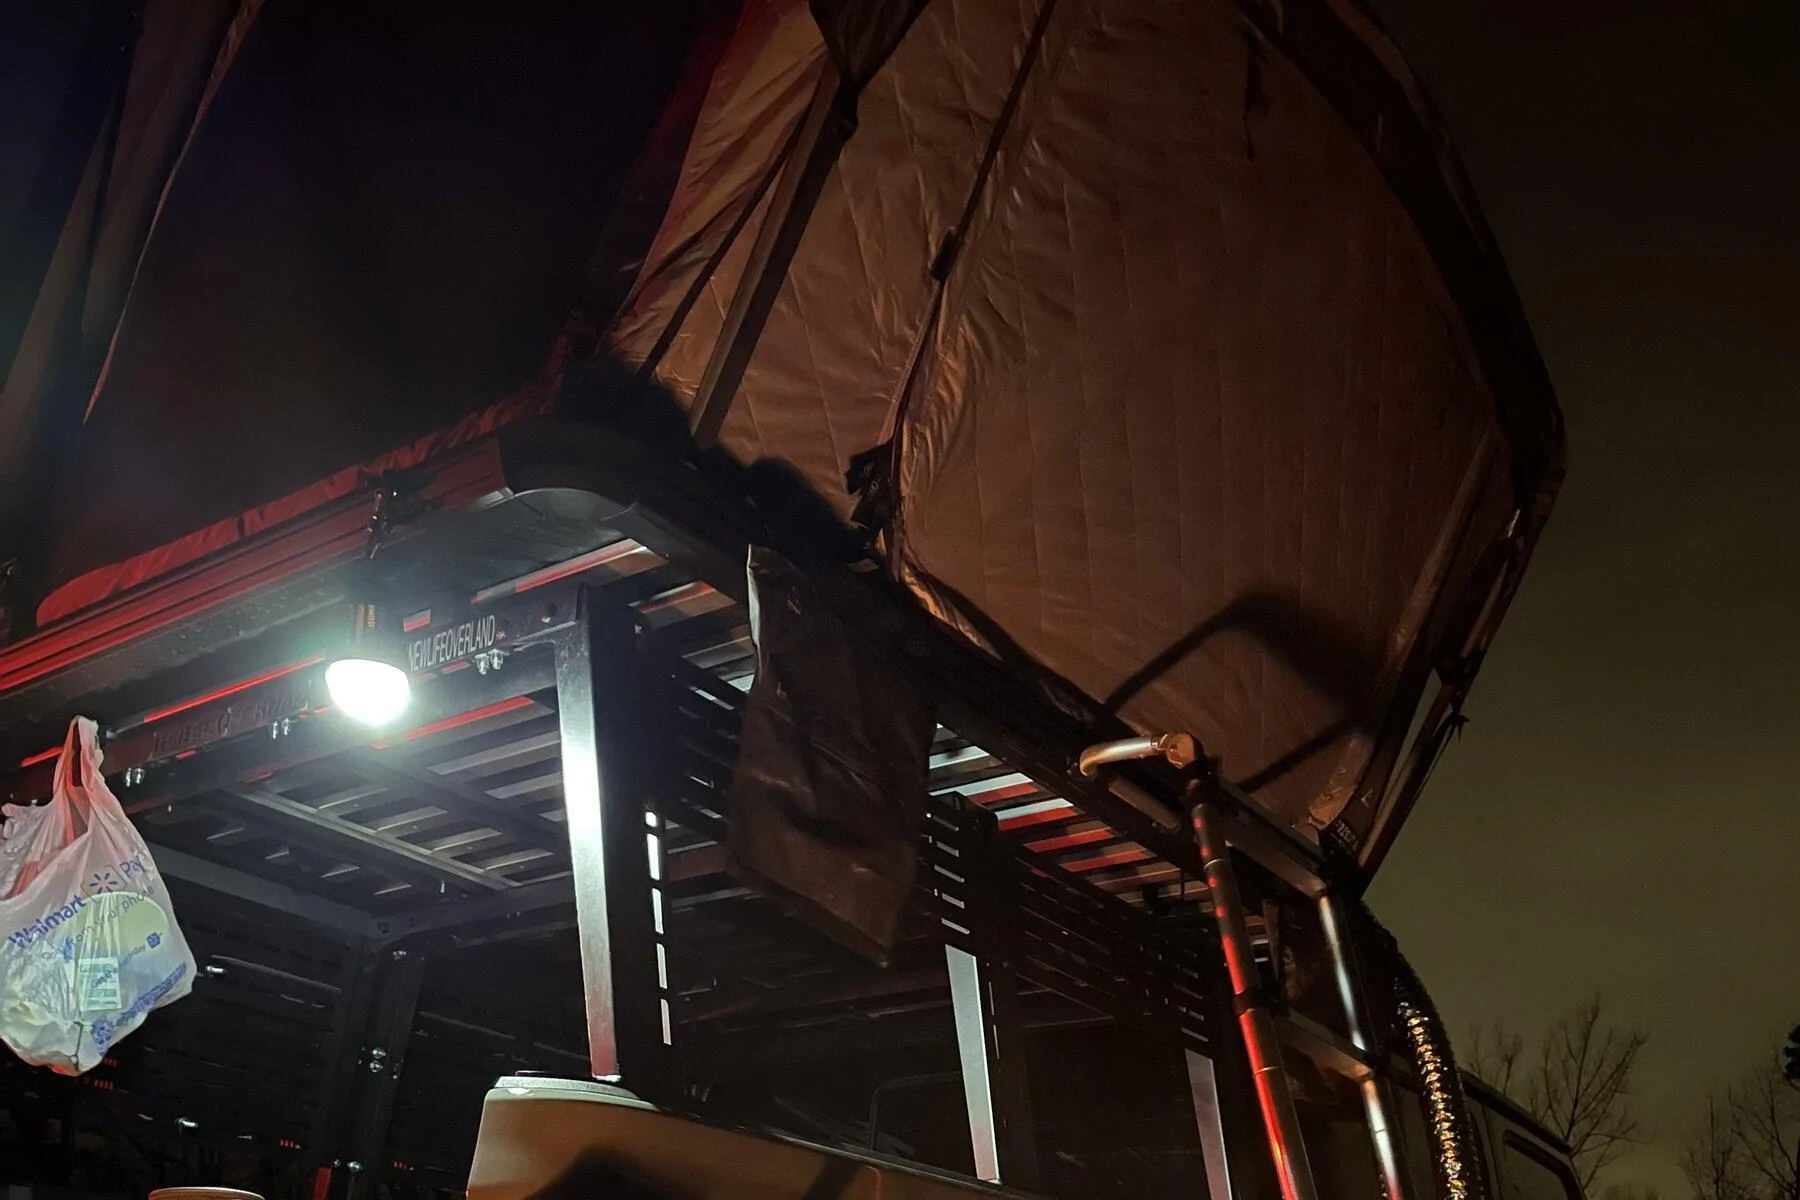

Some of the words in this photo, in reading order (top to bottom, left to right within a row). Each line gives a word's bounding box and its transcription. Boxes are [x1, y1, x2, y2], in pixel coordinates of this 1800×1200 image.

[407, 614, 496, 672] NEWLIFEOVERLAND
[8, 894, 87, 948] Walmart
[119, 855, 146, 880] Pay
[121, 884, 155, 914] phone
